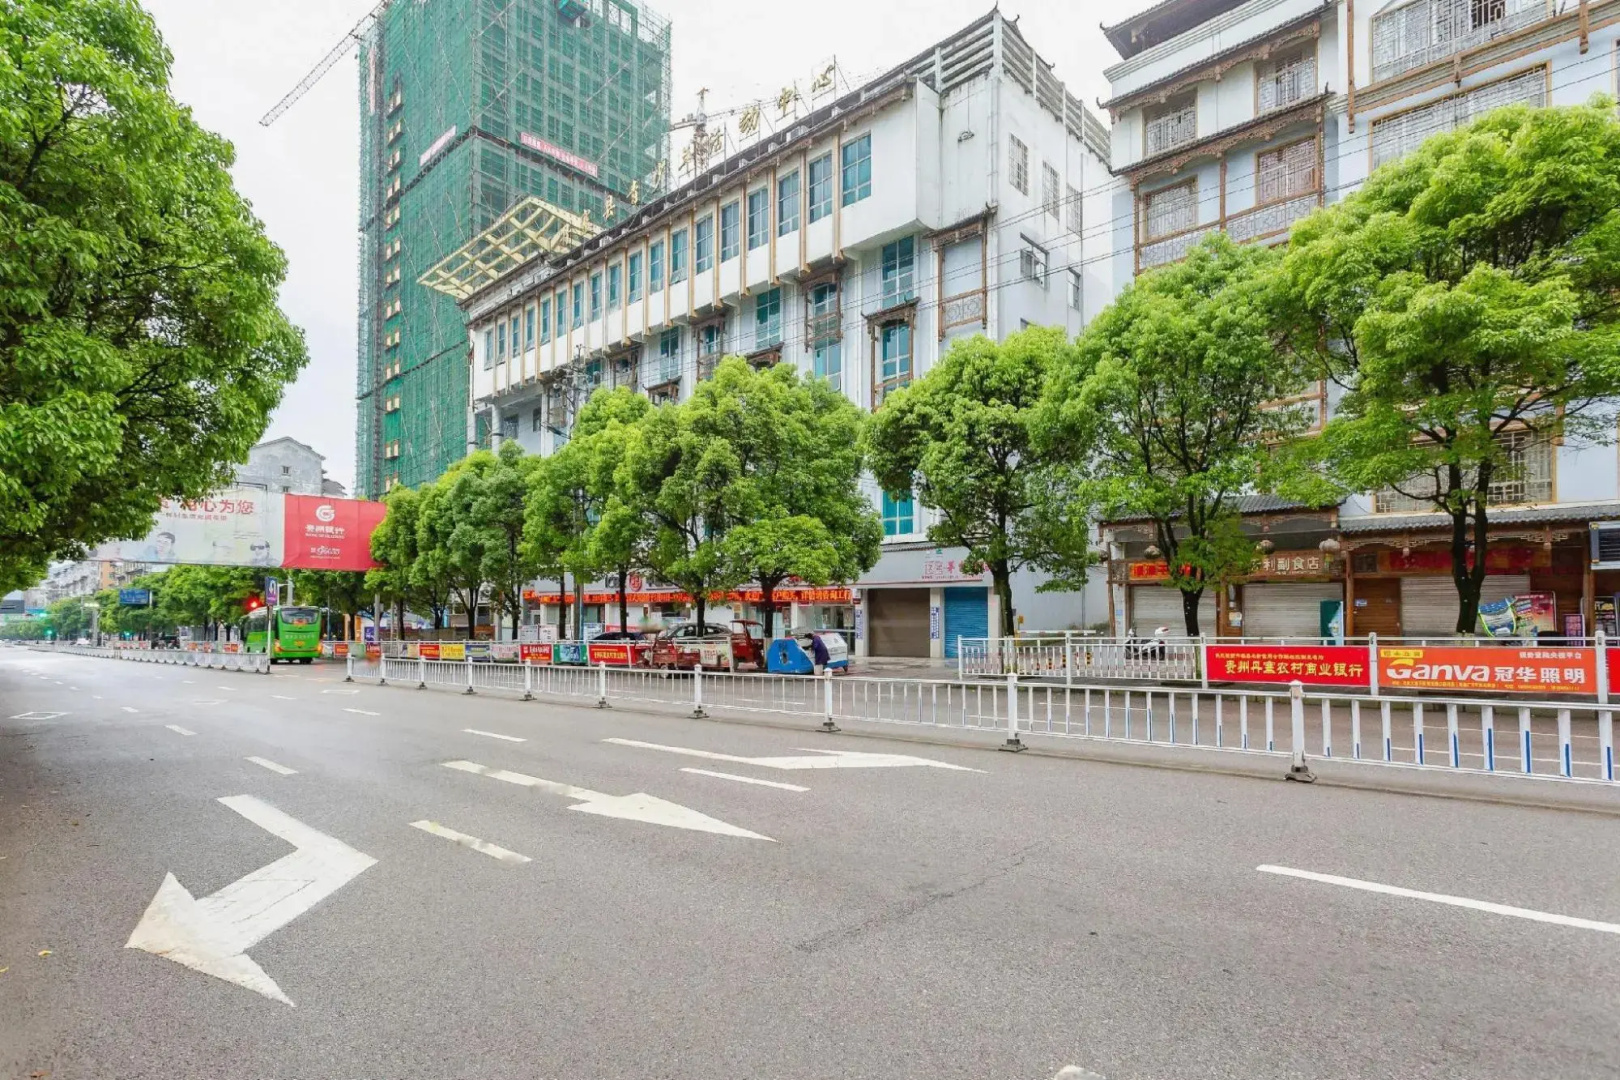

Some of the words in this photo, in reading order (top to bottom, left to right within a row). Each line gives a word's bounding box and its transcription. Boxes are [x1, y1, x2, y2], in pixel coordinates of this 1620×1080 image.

[1224, 660, 1364, 677] 贵州丹寨农村商业银行
[1386, 658, 1490, 682] Ganva
[1494, 666, 1585, 684] 冠华照明
